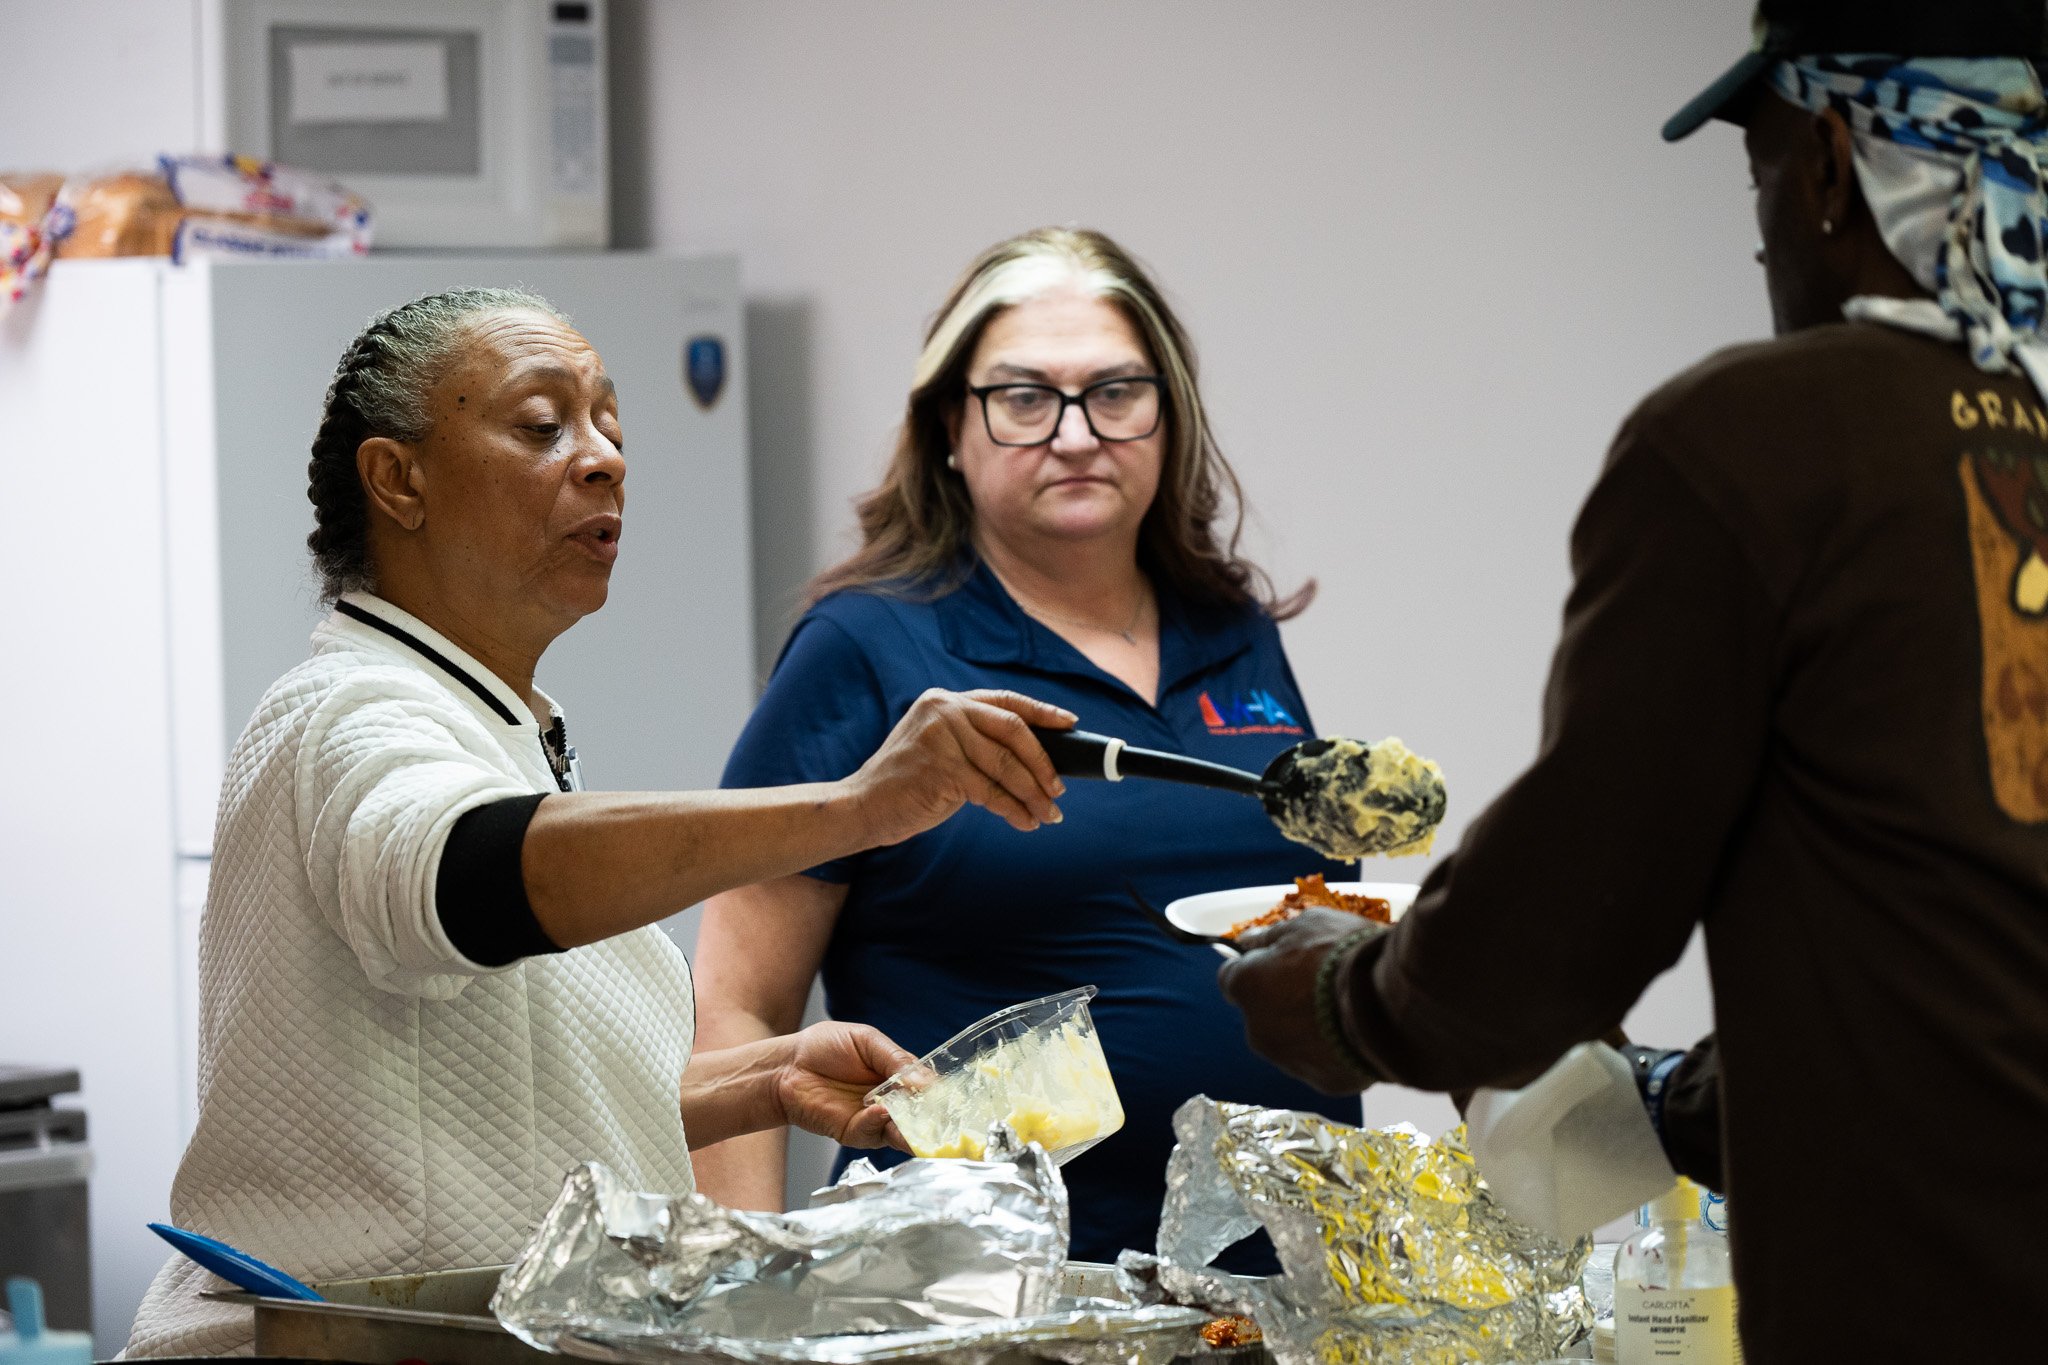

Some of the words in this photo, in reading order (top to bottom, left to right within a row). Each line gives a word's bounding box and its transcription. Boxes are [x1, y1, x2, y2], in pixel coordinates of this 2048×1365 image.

[1642, 1300, 1690, 1310] CARLOTTA
[1652, 1315, 1673, 1324] Hand
[1674, 1314, 1710, 1324] Sanitizer
